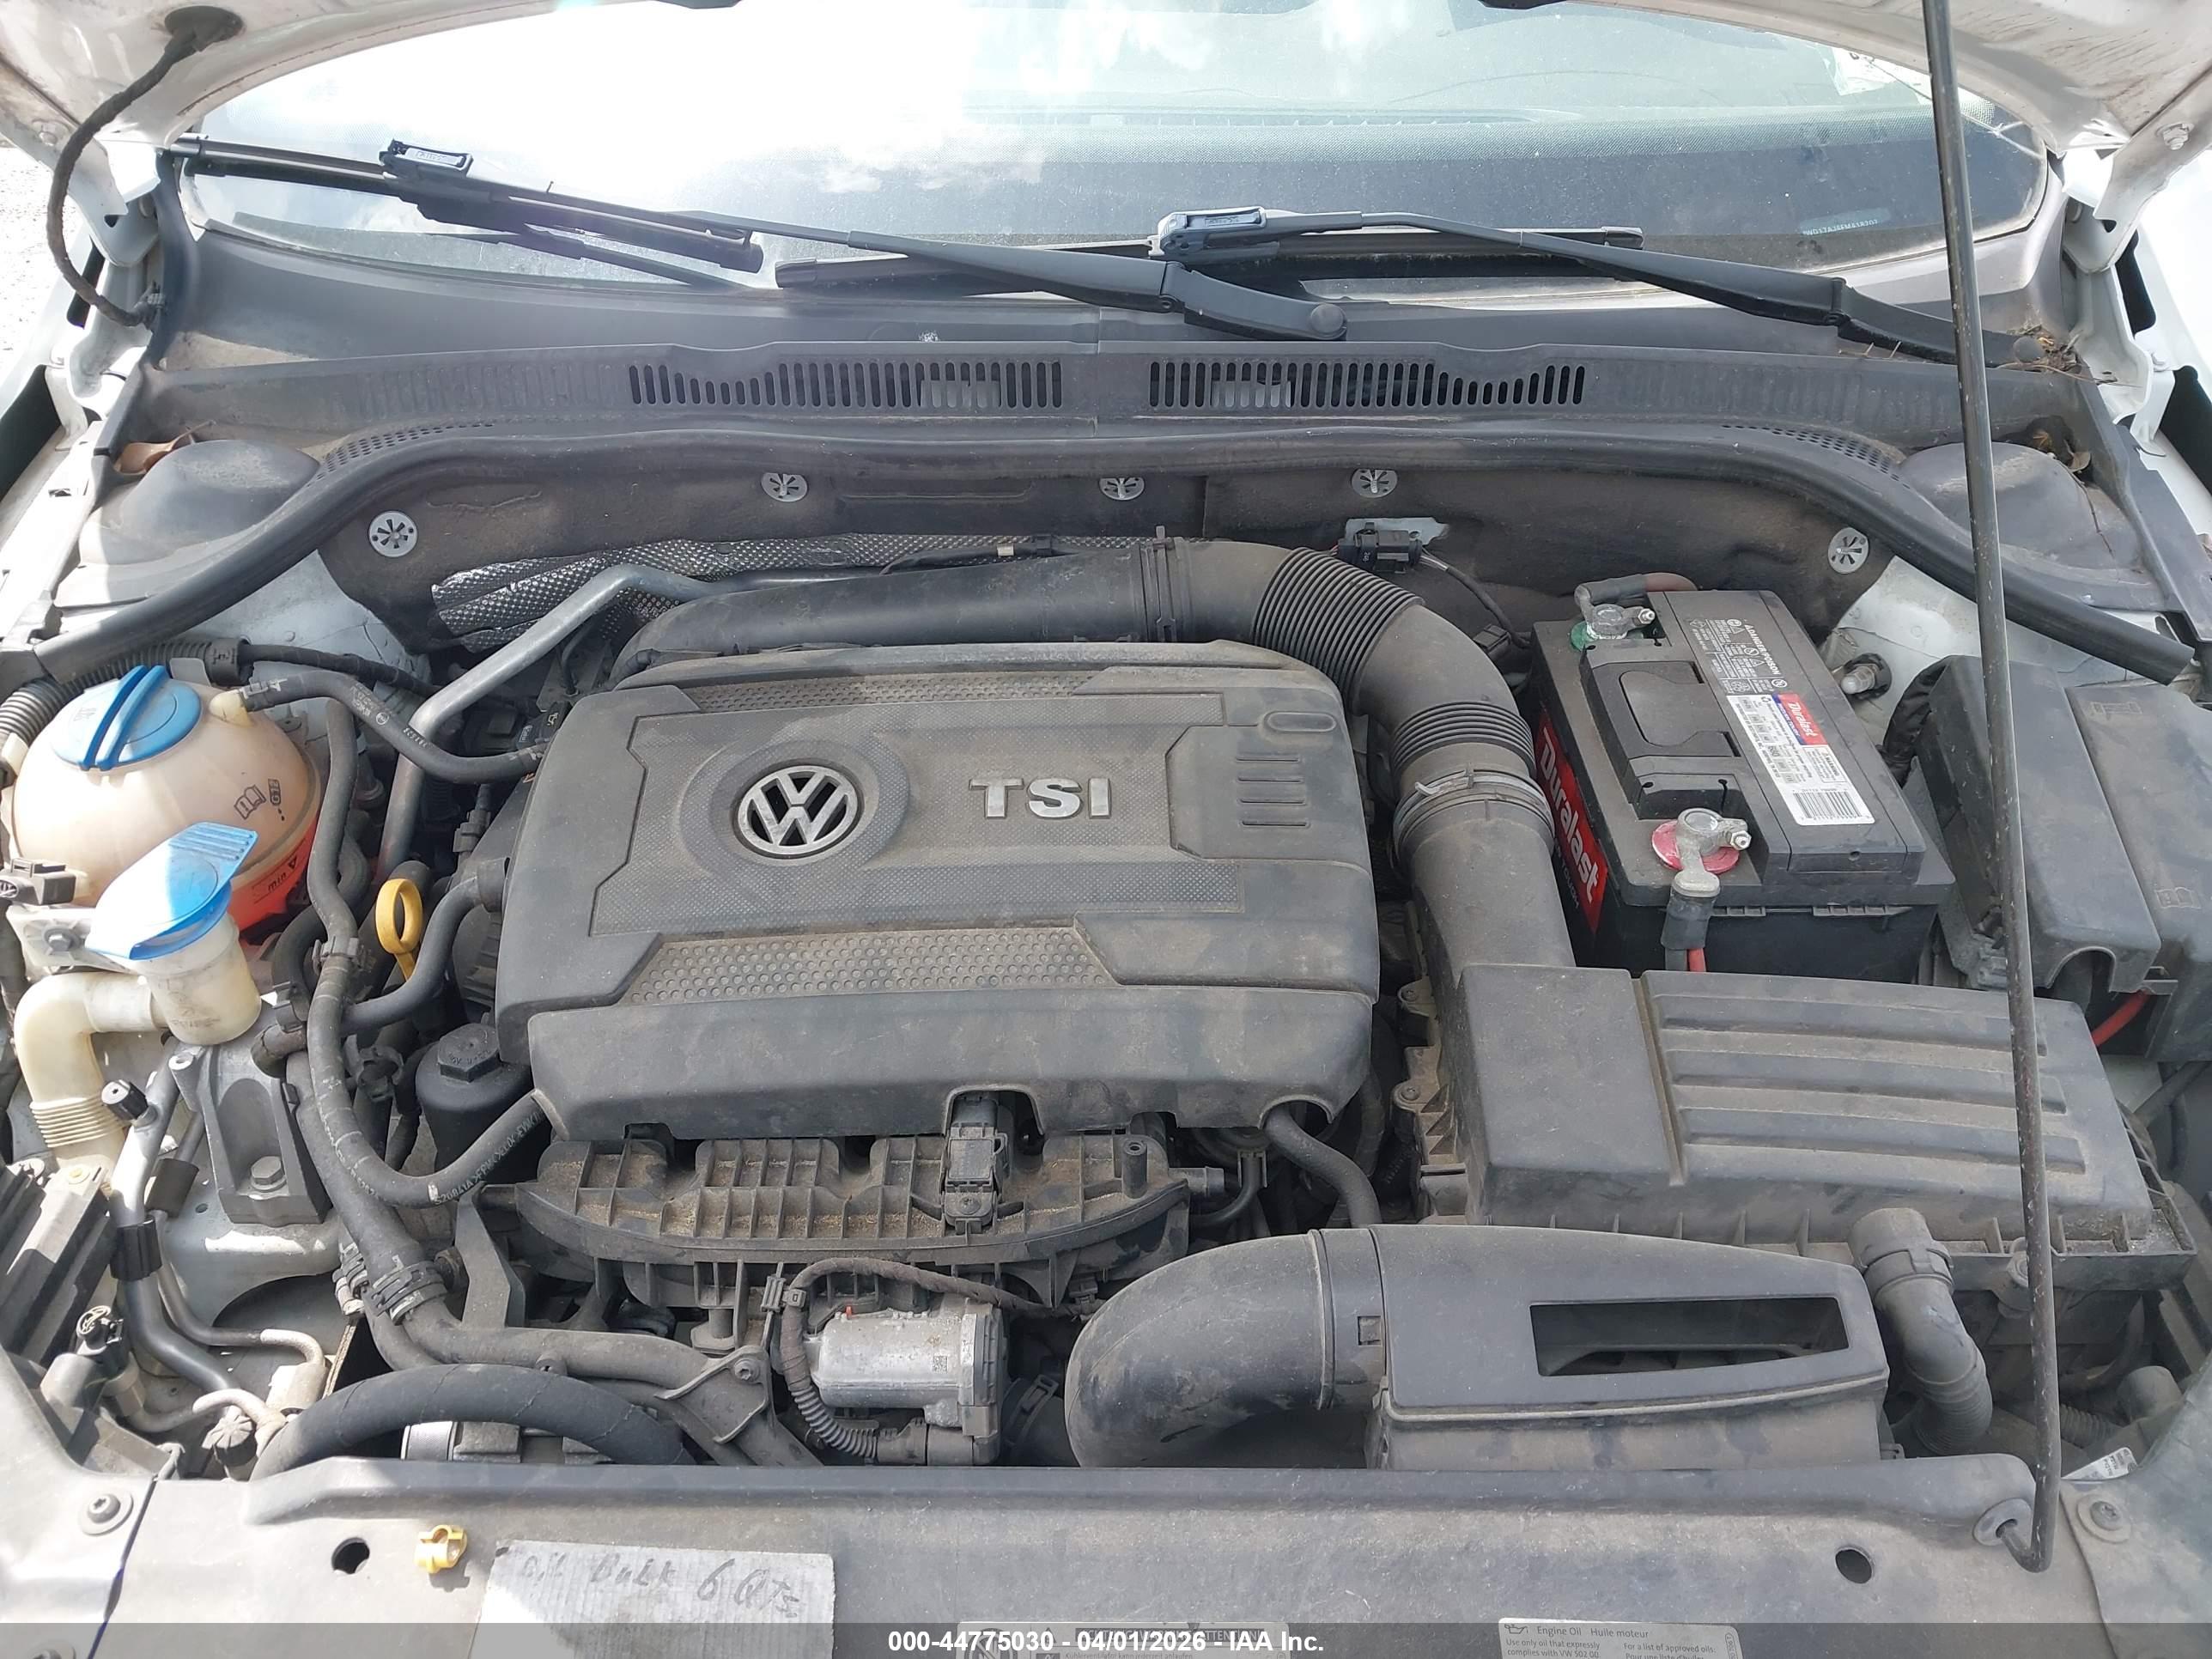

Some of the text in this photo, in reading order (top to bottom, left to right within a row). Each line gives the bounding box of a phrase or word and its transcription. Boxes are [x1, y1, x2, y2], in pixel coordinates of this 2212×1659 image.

[1788, 702, 1818, 737] Duralast
[736, 765, 859, 856] VW
[969, 778, 1113, 820] TSI
[1540, 726, 1599, 904] Duralast
[267, 872, 288, 891] min
[697, 1558, 735, 1601] 6
[1522, 1638, 1537, 1649] only
[1549, 1639, 1565, 1648] that
[1566, 1641, 1601, 1652] expressly
[1537, 1626, 1649, 1638] Engine Oil Huile moteur
[1507, 1648, 1540, 1659] complies
[1541, 1649, 1559, 1657] with
[1559, 1650, 1573, 1658] VW
[1574, 1650, 1588, 1659] 502
[1644, 1643, 1655, 1651] list
[1656, 1644, 1664, 1652] of
[1665, 1644, 1699, 1655] approved
